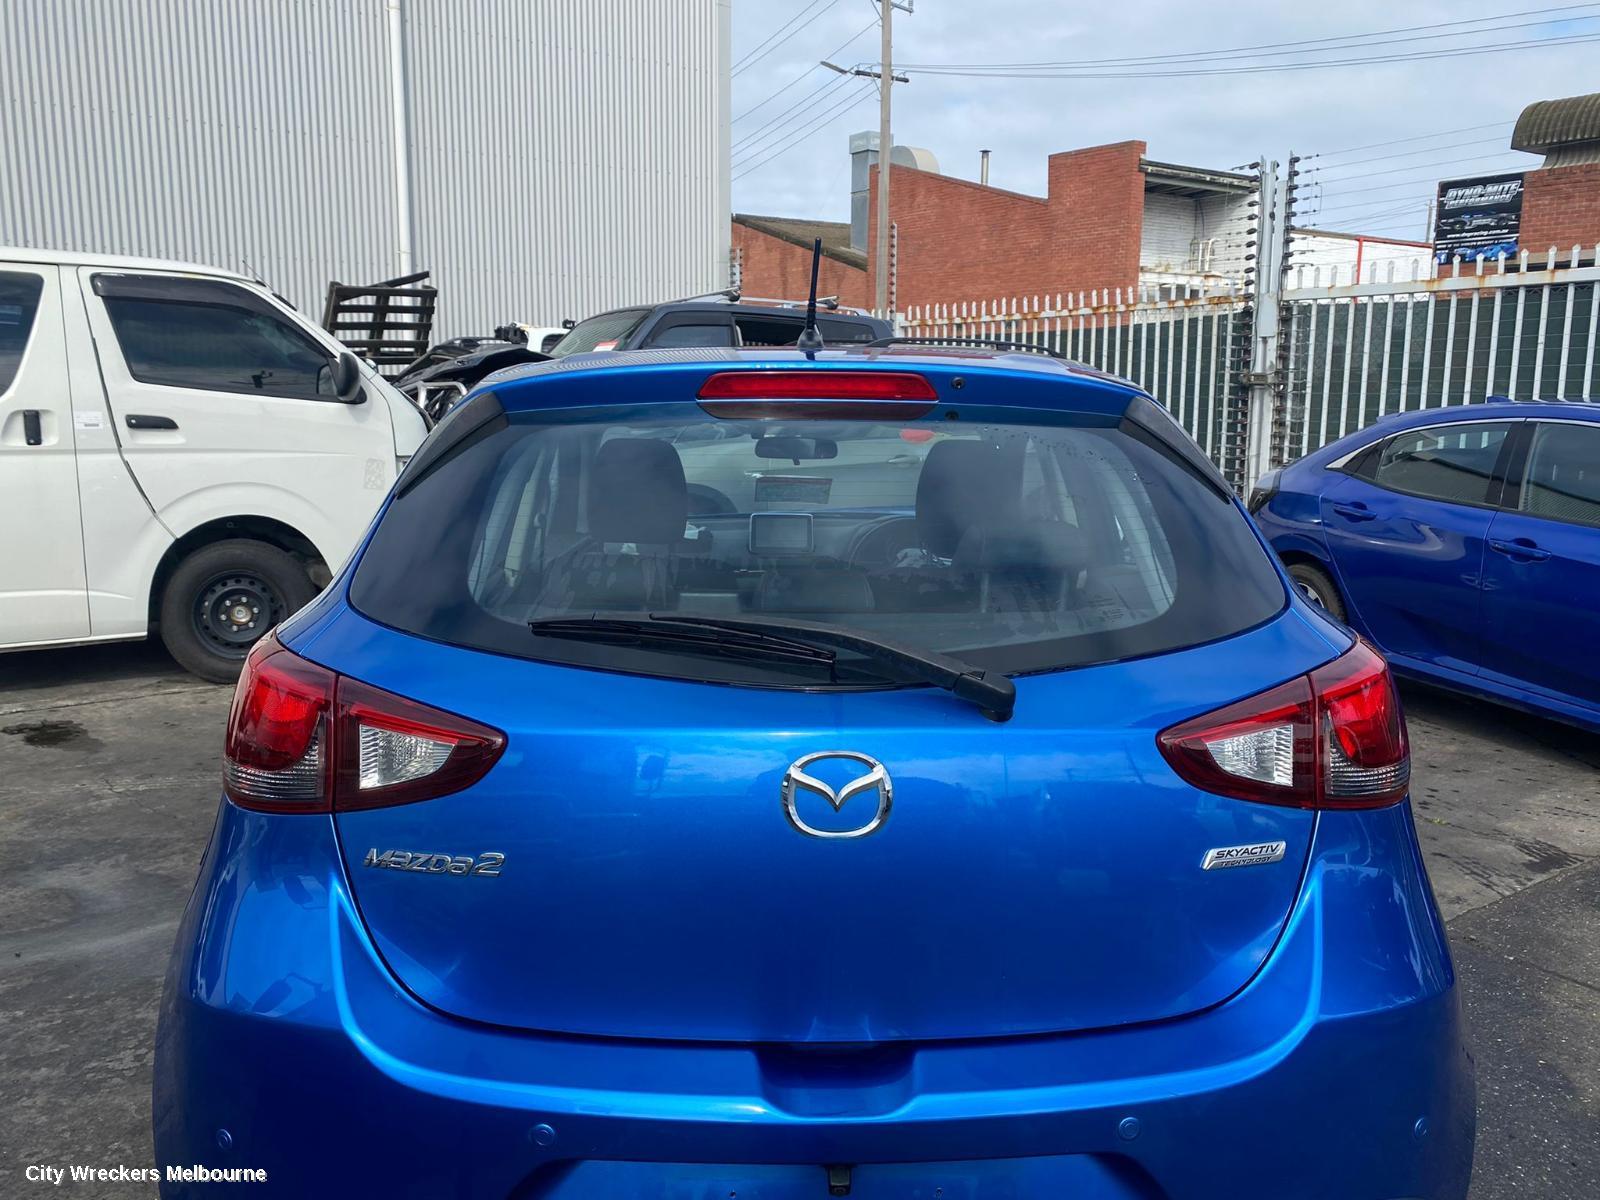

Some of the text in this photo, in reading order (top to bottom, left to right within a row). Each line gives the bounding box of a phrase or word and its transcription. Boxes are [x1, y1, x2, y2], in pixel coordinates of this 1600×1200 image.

[1447, 182, 1520, 200] DYNO-MITE
[1447, 194, 1512, 207] PERFORMANCE
[1215, 844, 1279, 859] SKYACTIV
[1221, 856, 1272, 867] TECHNOLOGY
